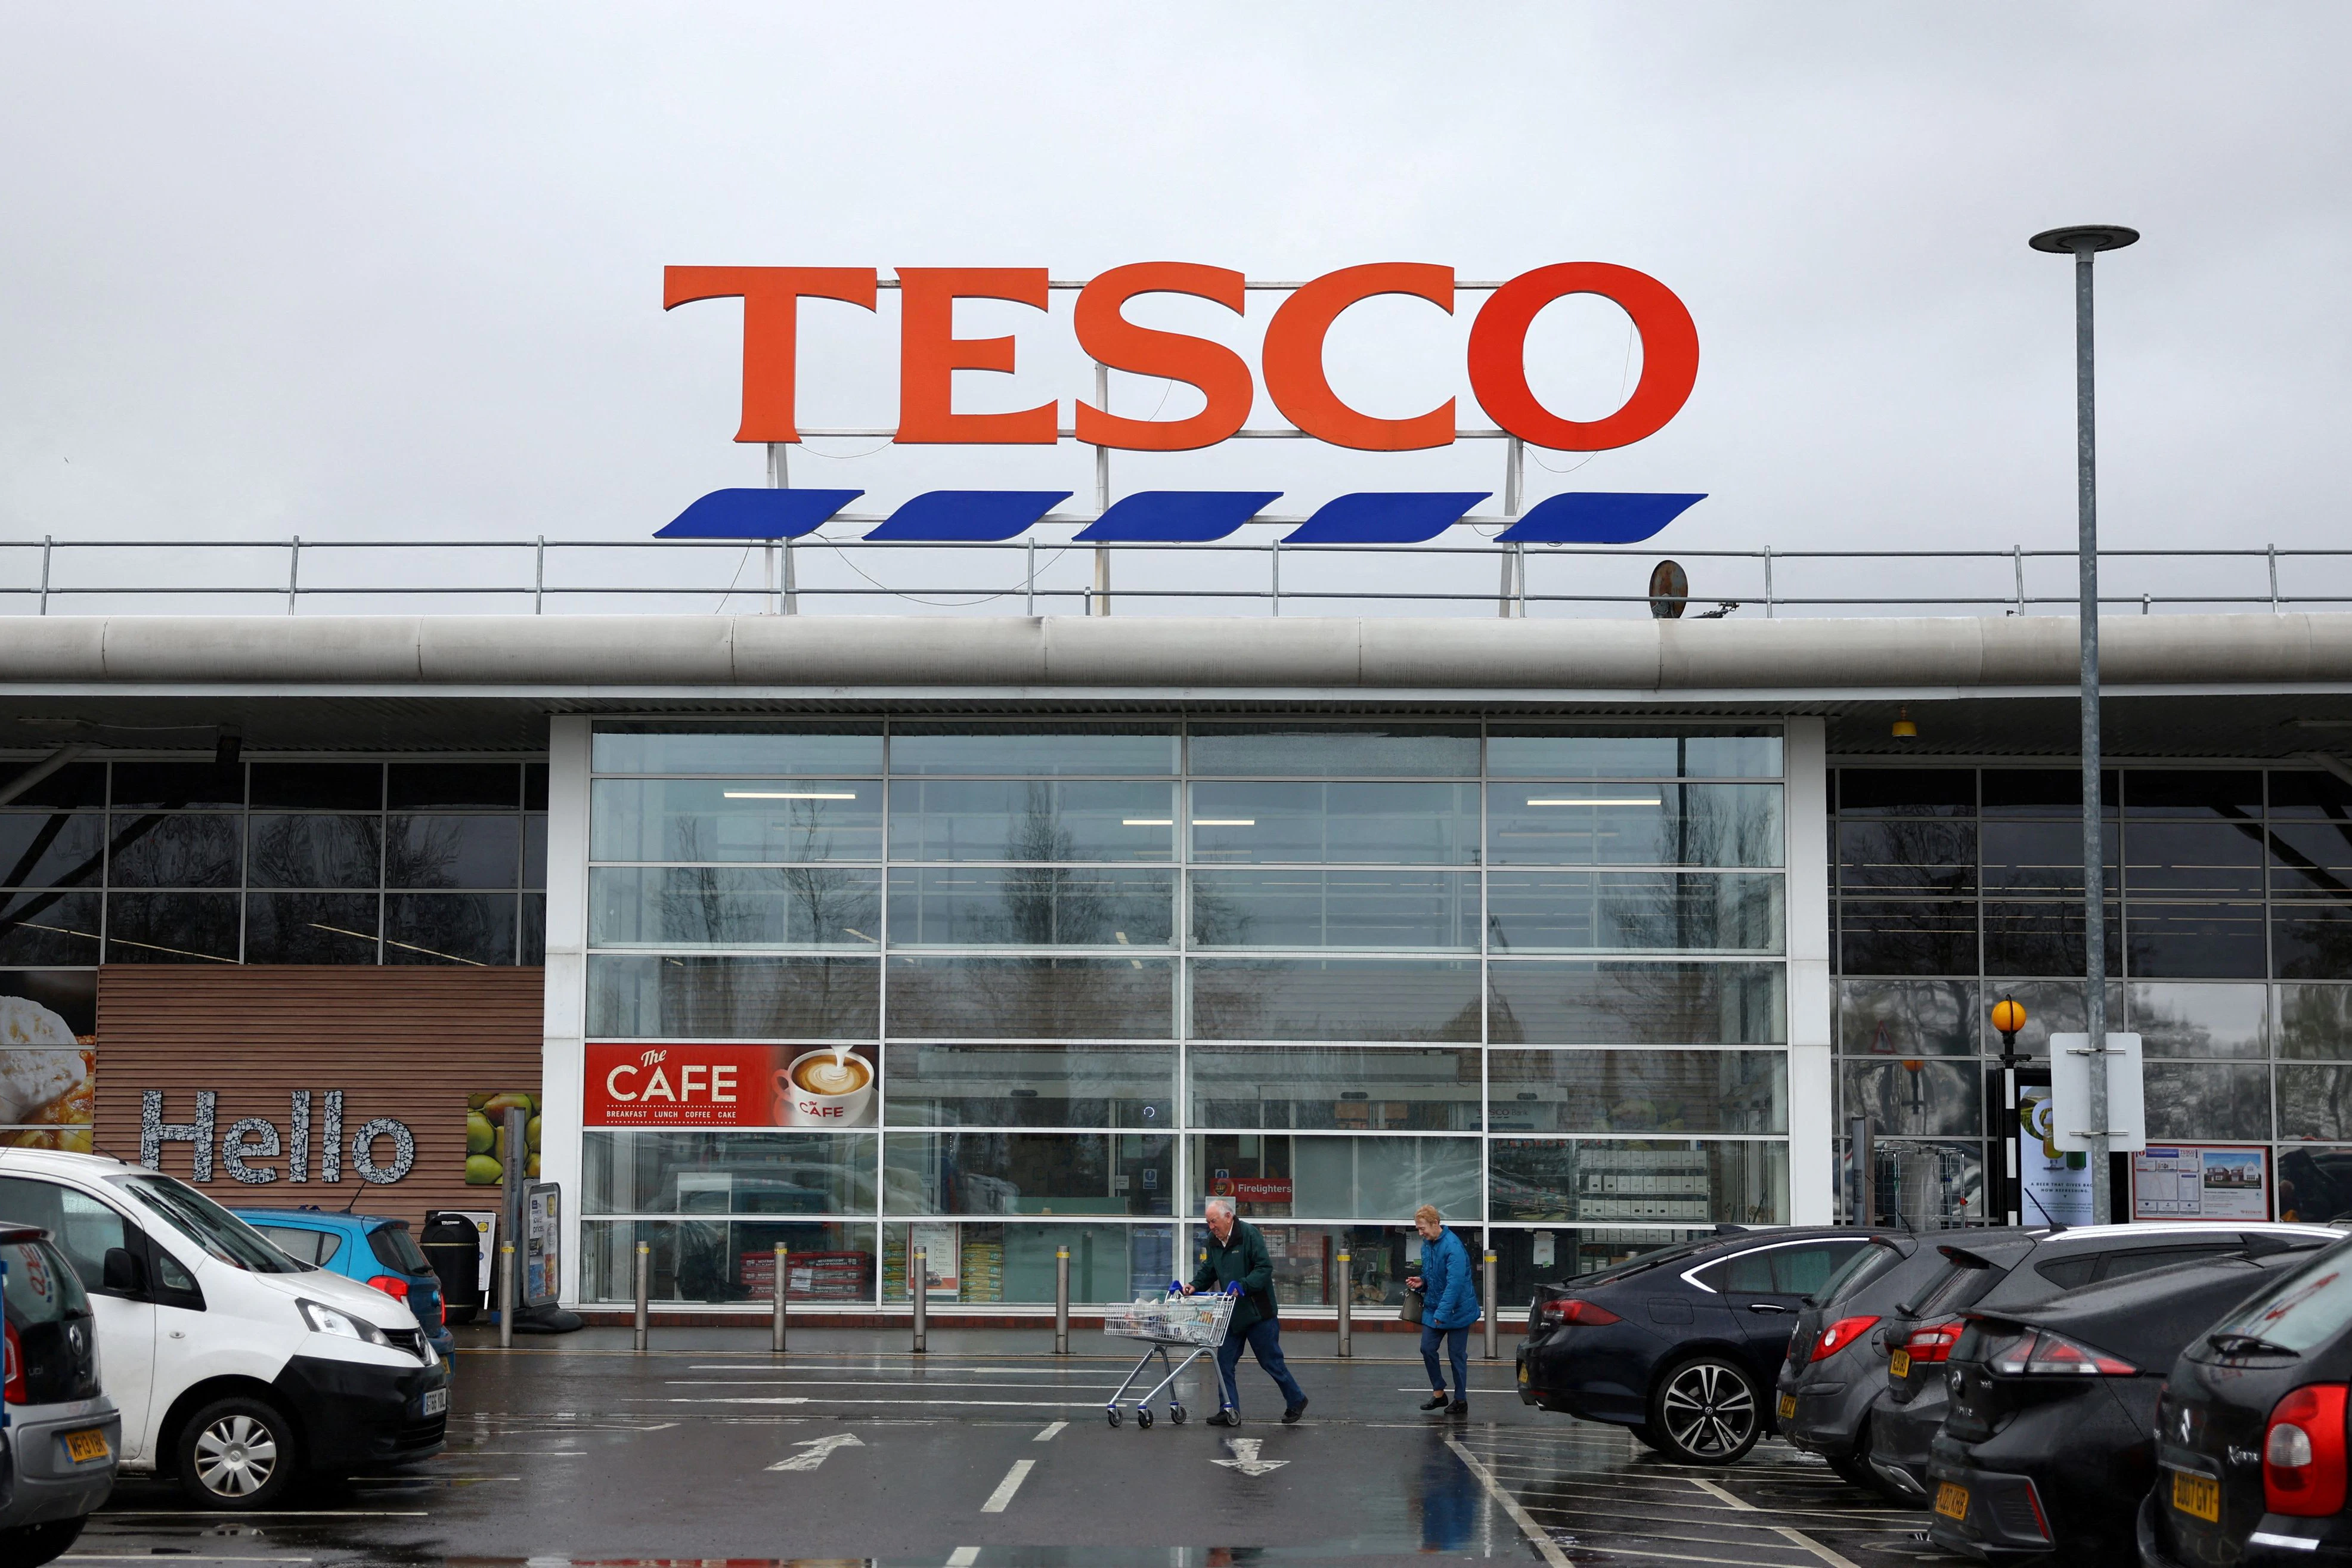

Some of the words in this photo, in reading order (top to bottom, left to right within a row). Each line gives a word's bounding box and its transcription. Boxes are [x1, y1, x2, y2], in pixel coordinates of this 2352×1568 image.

[663, 261, 1700, 452] TESCO
[641, 1049, 667, 1068] The
[606, 1065, 737, 1103] CAFE
[606, 1110, 647, 1118] BREAKFAST
[654, 1110, 678, 1118] LUNCH
[685, 1110, 711, 1118] COFFEE
[718, 1110, 736, 1118] CAKE
[800, 1102, 844, 1117] CAFE
[140, 1089, 415, 1185] Hello
[1238, 1184, 1292, 1194] Firelighters
[2197, 1481, 2214, 1515] GVT
